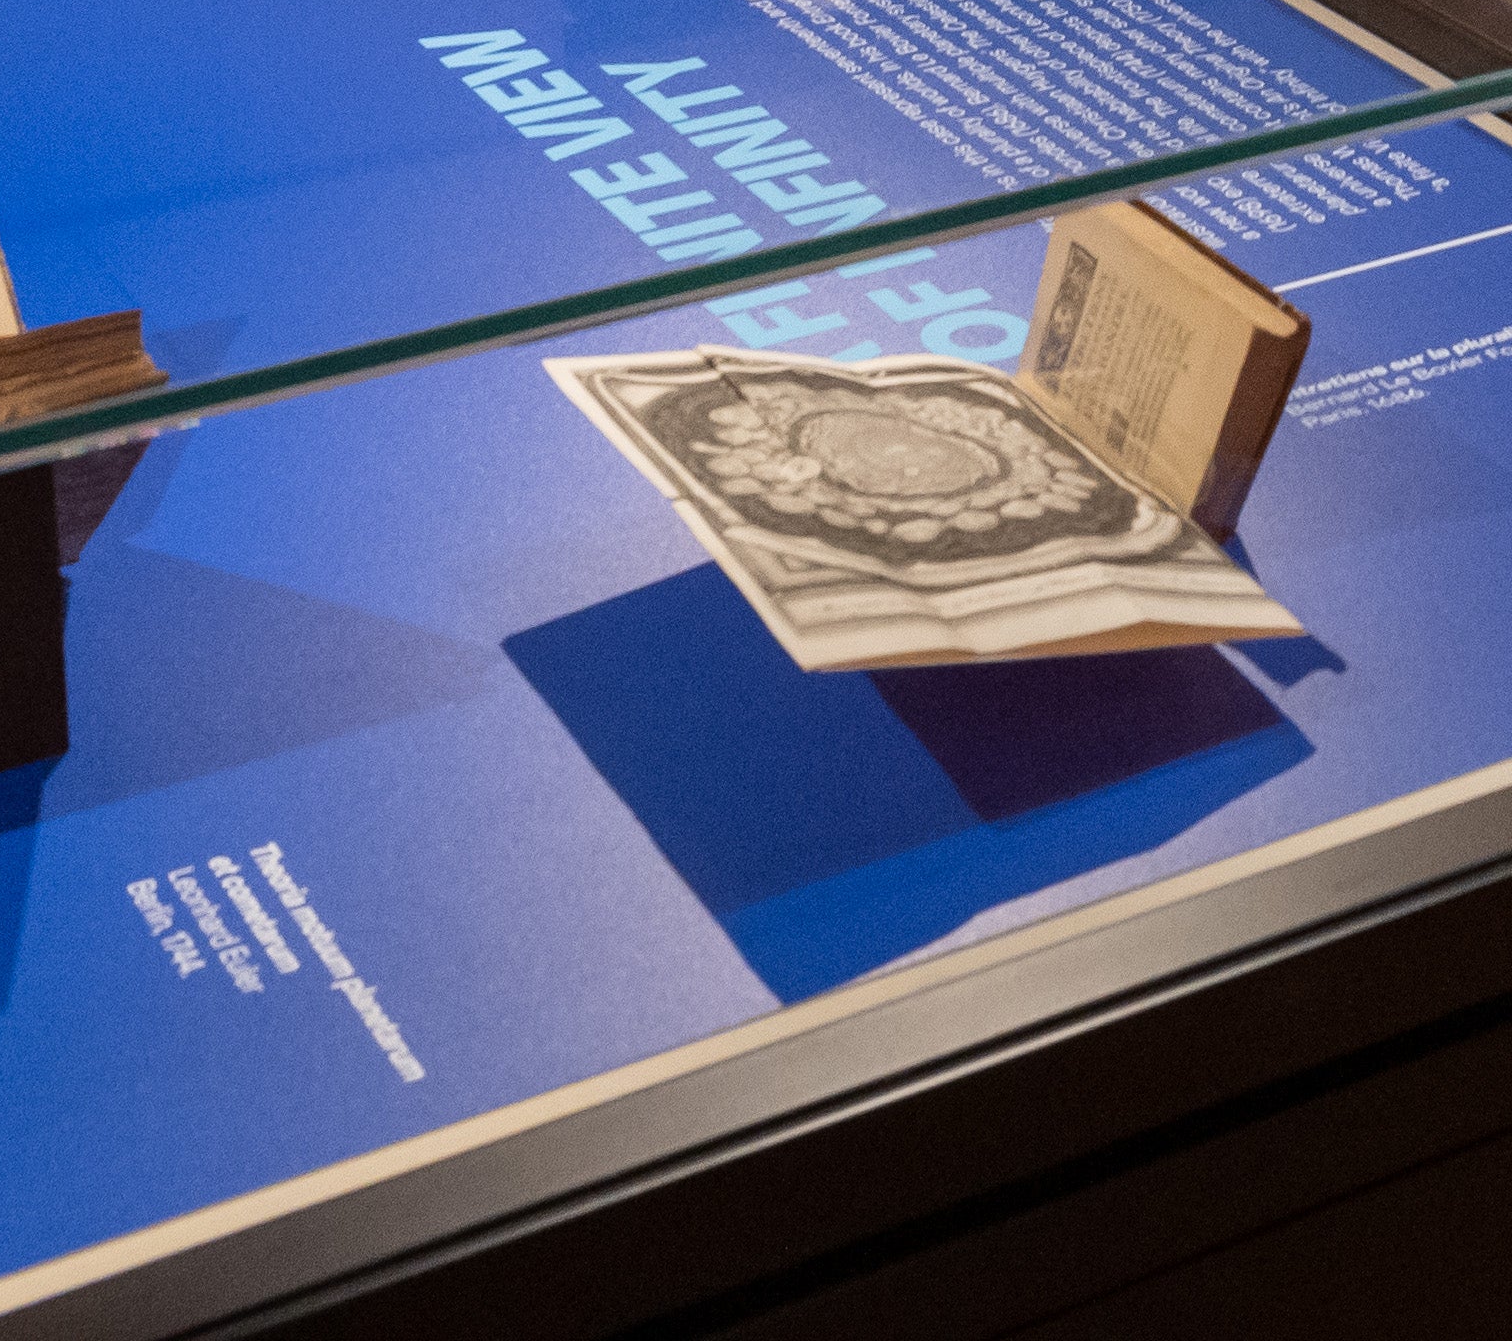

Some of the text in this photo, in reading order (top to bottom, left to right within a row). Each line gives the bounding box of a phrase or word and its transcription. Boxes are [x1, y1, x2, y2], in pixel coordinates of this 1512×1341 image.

[417, 28, 635, 163] VIEW
[864, 280, 1031, 364] OF
[1288, 365, 1388, 400] ntretiens
[161, 930, 207, 979] 1744
[167, 865, 265, 994] Leonhard Euler
